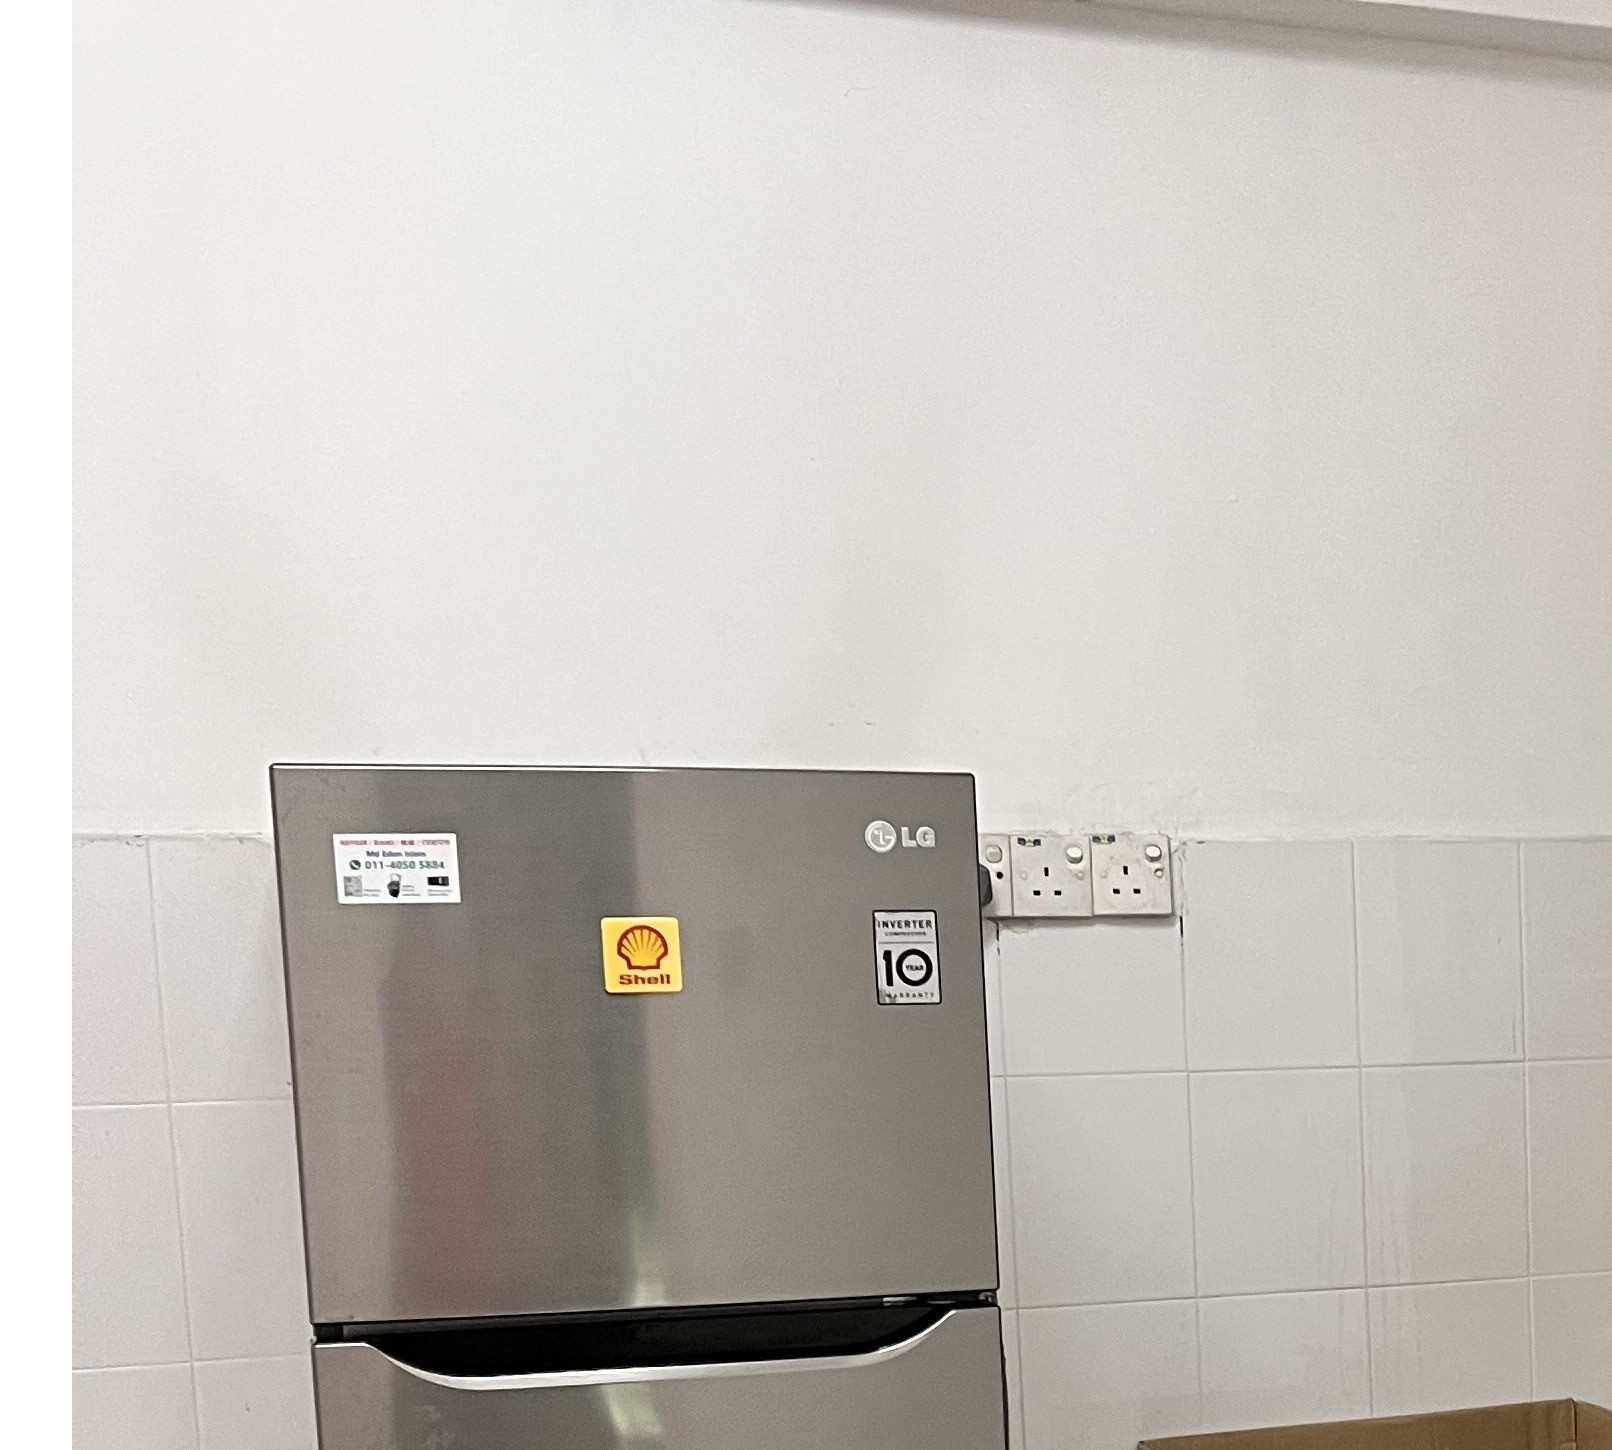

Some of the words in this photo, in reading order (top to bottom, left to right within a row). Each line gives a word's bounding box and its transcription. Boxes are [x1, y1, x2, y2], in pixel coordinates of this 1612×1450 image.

[901, 826, 935, 848] LG
[877, 919, 933, 929] INVERTER
[882, 948, 933, 986] 10
[619, 973, 671, 985] Shell
